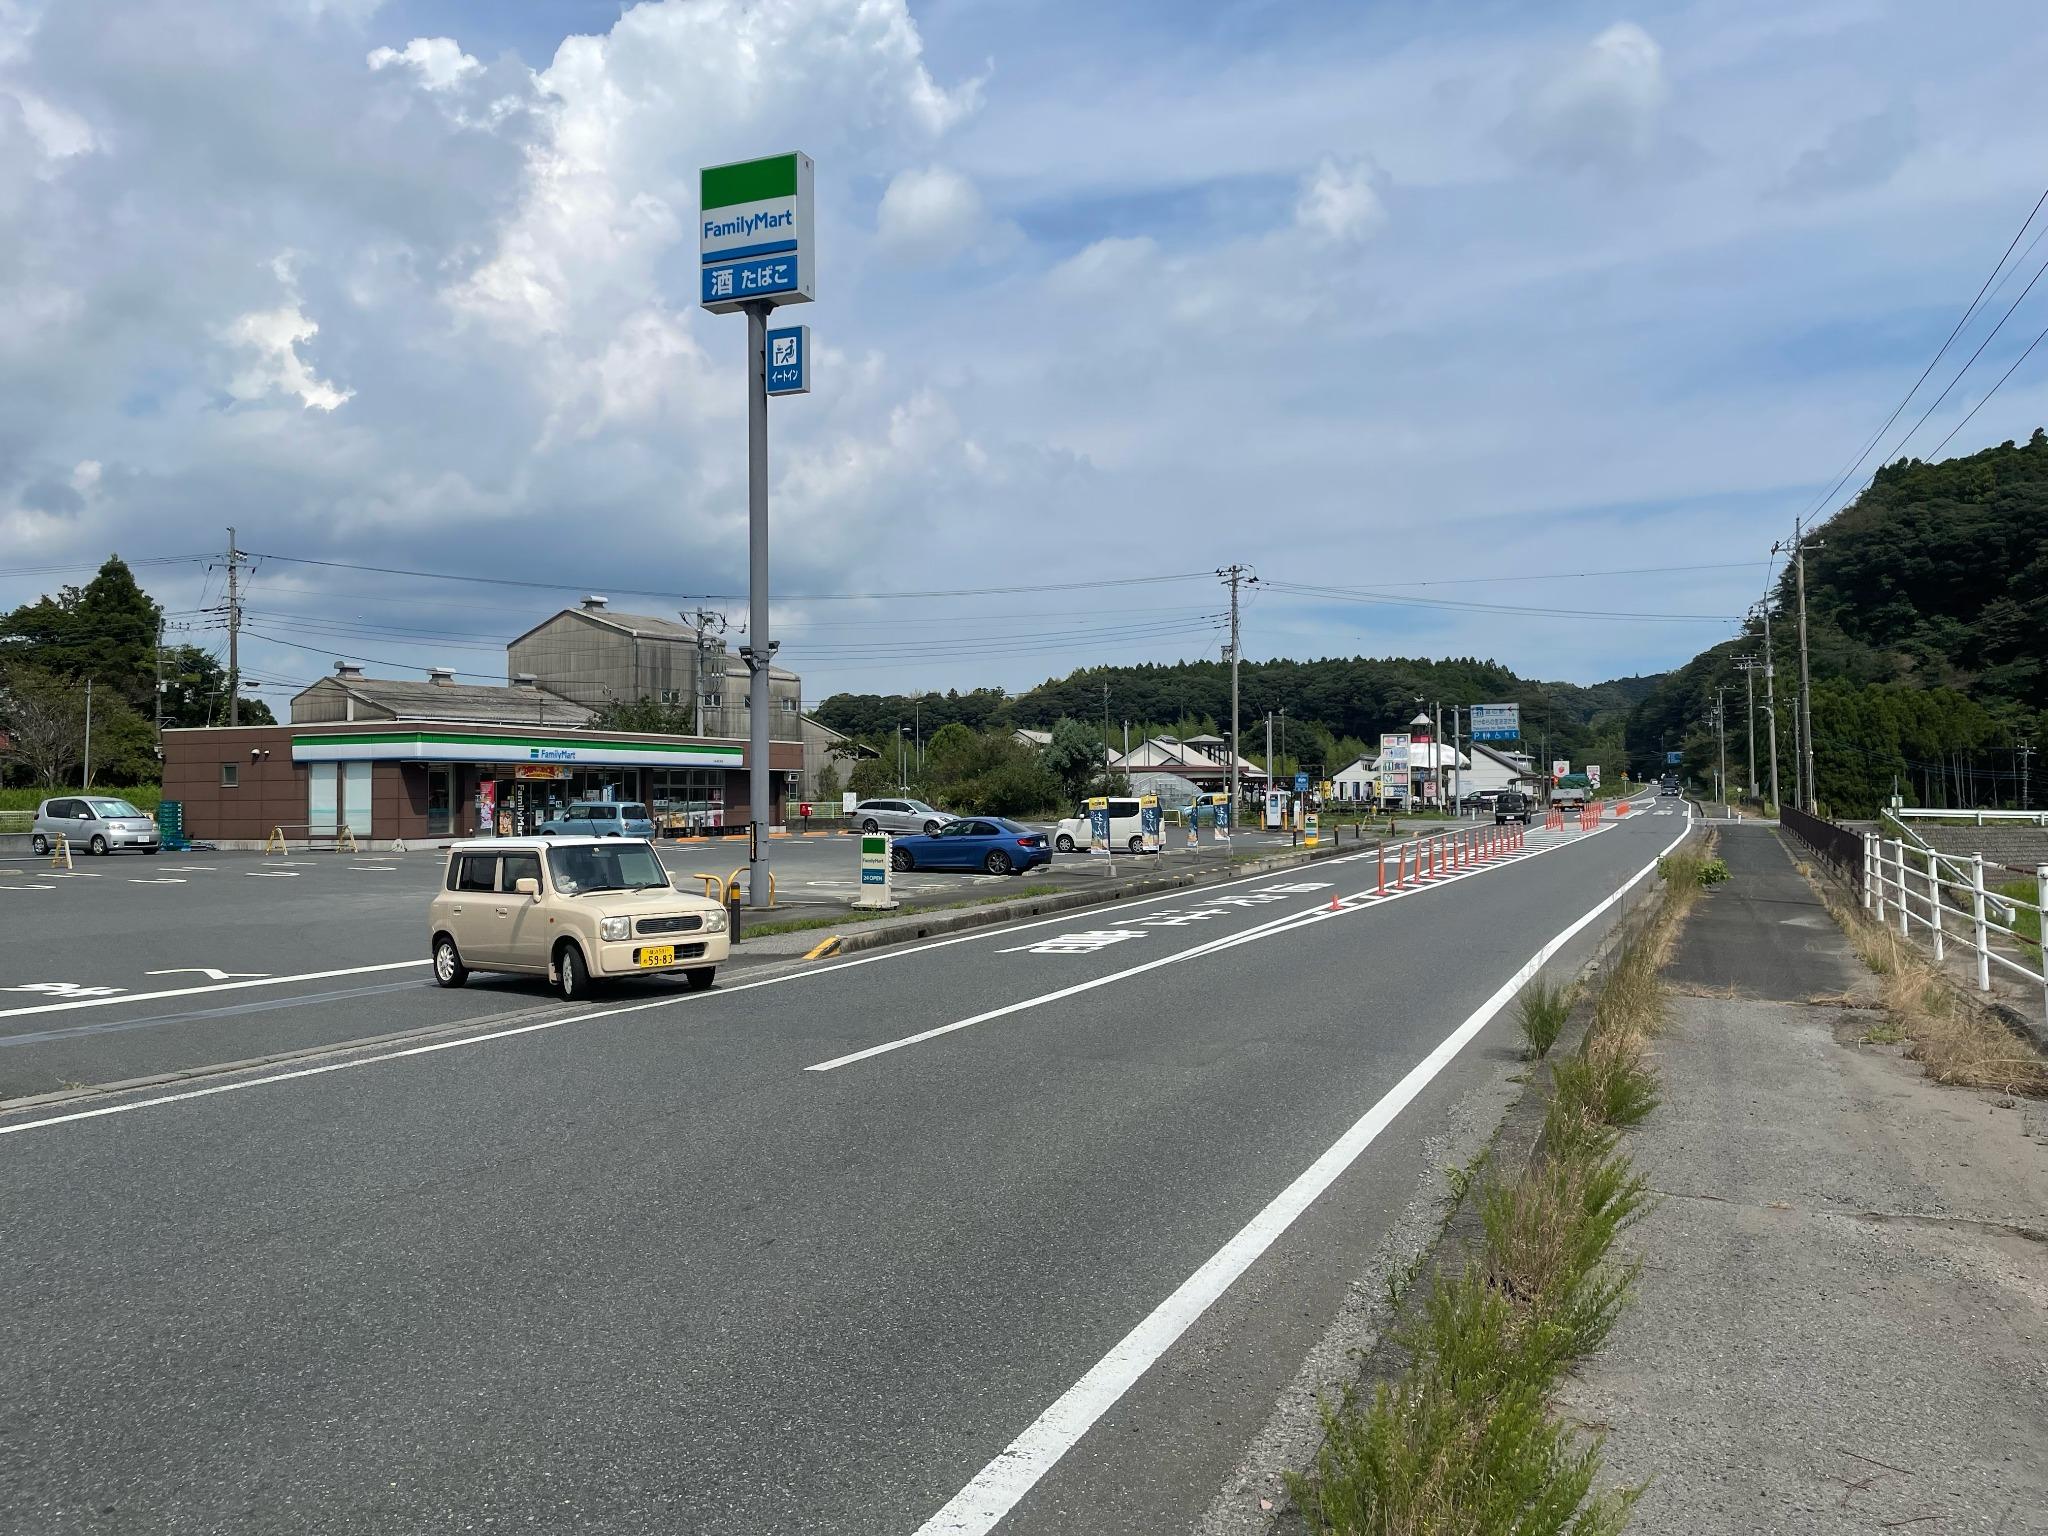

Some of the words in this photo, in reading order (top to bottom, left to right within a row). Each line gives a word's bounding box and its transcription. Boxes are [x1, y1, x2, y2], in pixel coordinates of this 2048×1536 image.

[704, 209, 792, 239] FamilyMart
[711, 269, 733, 296] 酒
[741, 264, 789, 289] たばこ
[771, 369, 799, 382] イートイン
[541, 750, 576, 760] FamilyMart
[517, 784, 525, 837] FamilyMar
